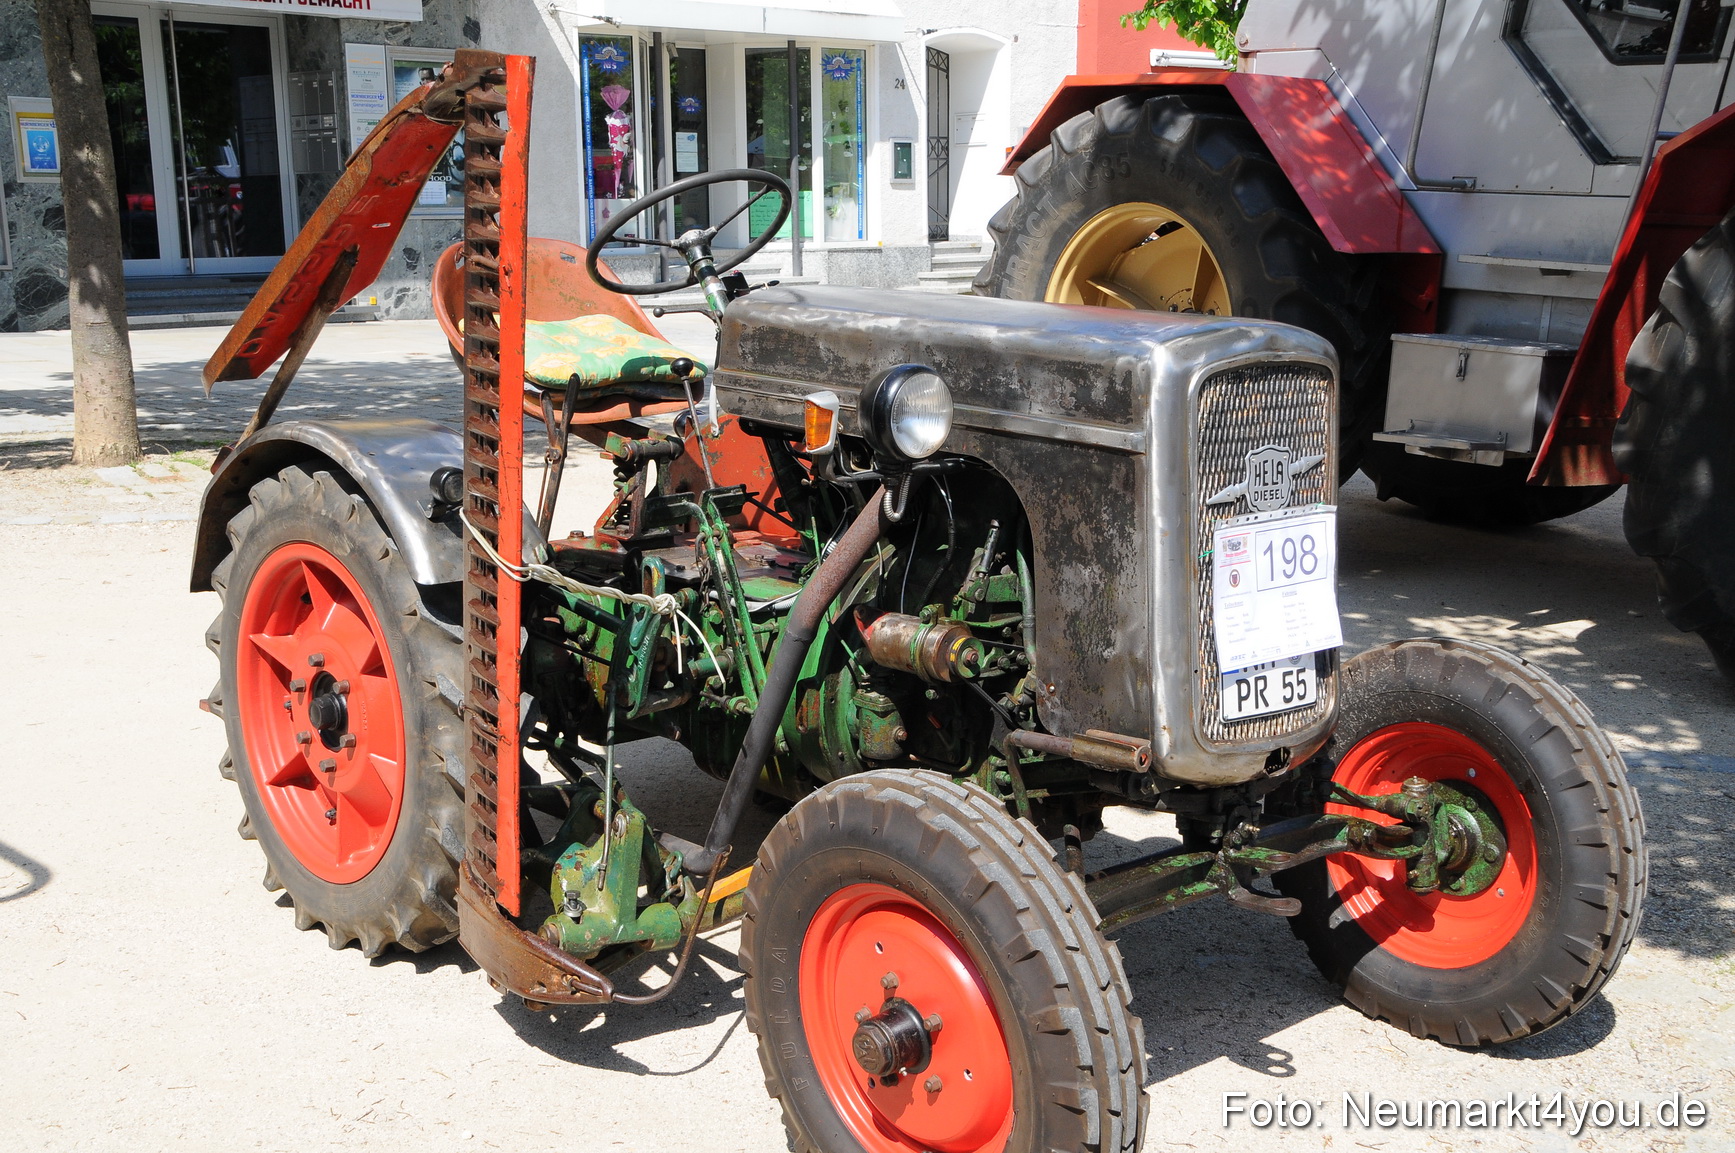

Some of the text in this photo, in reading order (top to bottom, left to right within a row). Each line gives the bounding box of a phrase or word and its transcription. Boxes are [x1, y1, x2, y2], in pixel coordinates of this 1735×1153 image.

[894, 78, 906, 90] 24
[1254, 459, 1284, 487] HELA
[1253, 489, 1285, 502] DIESEL
[1263, 534, 1318, 582] 198
[1235, 667, 1307, 713] PR 55
[770, 946, 810, 1092] FULDA
